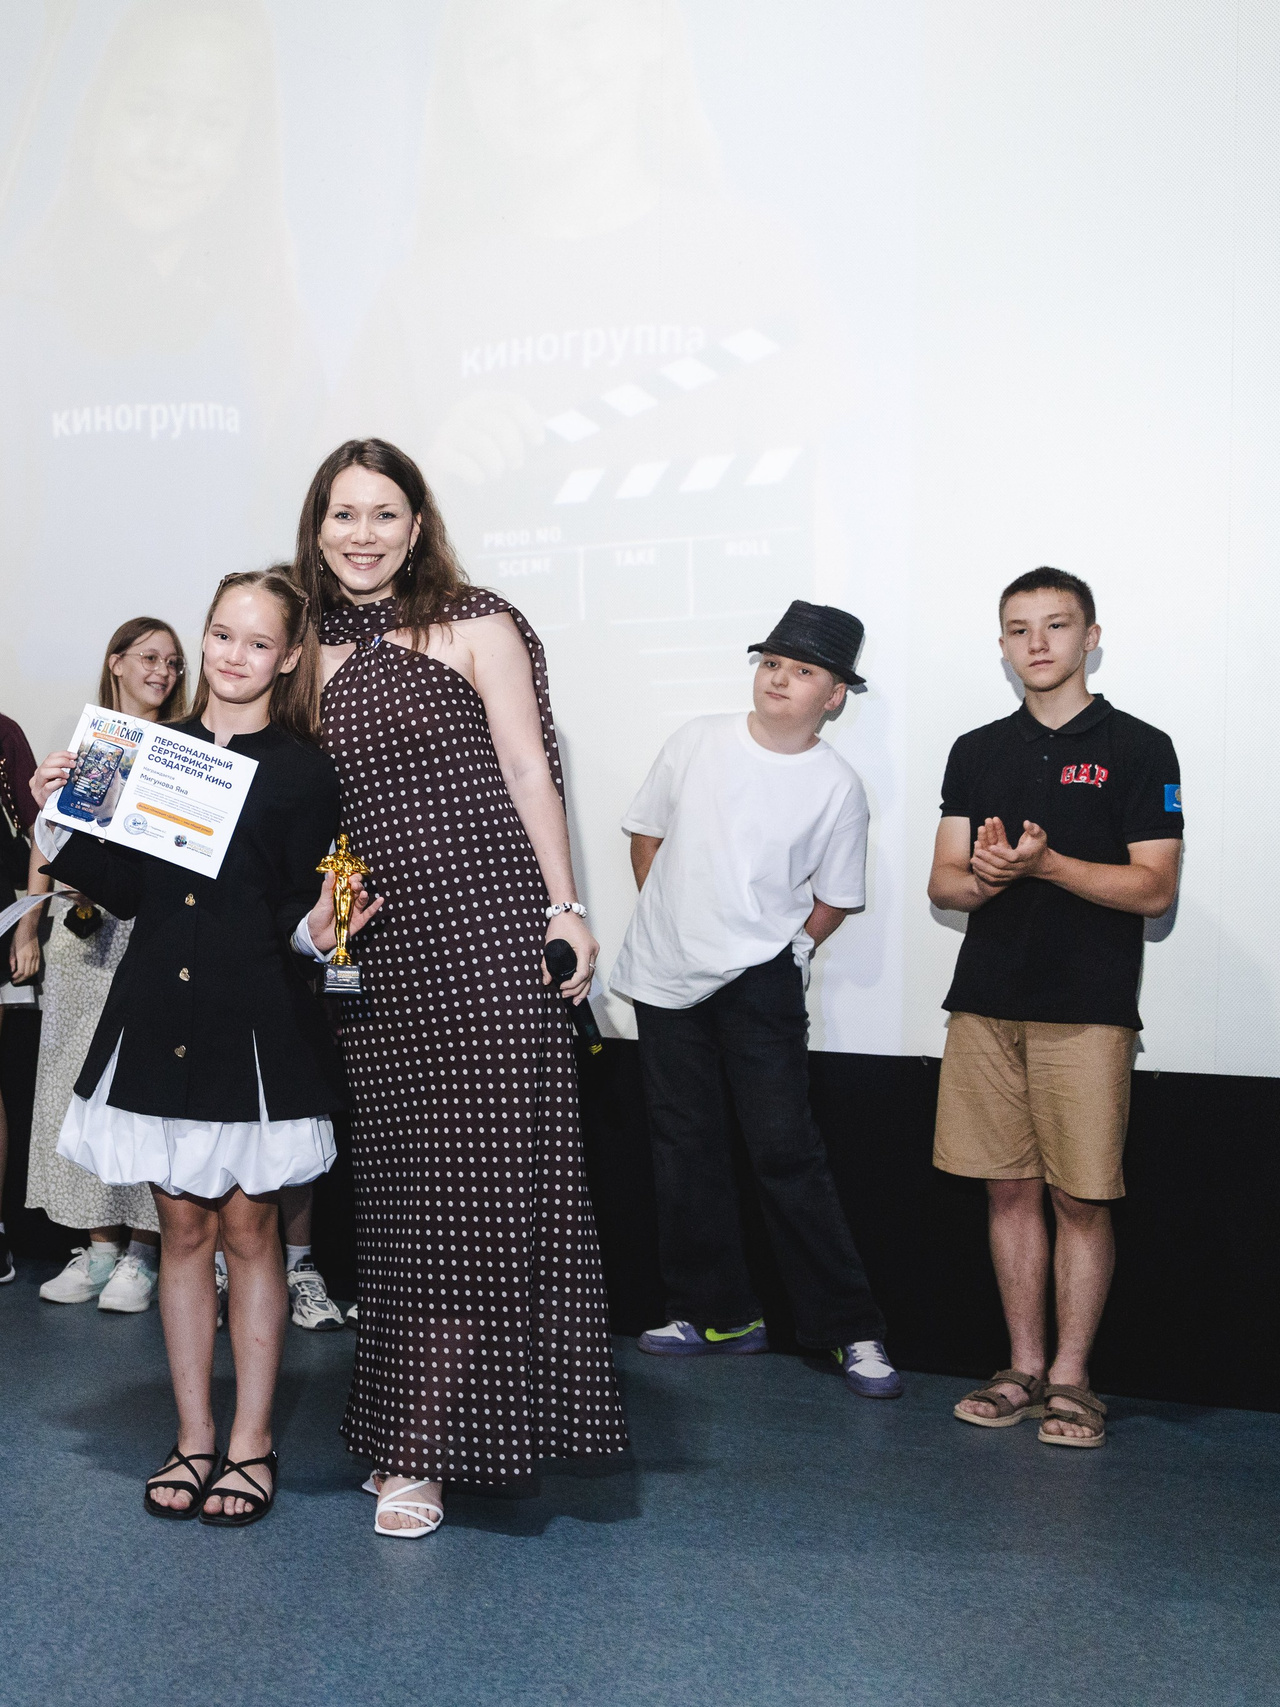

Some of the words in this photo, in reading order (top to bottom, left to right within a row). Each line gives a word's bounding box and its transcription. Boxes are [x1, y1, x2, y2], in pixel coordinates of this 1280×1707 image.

[459, 324, 708, 379] киногруппа
[51, 402, 241, 440] киногруппа
[90, 718, 144, 744] МЕДИАСКОП
[151, 745, 214, 773] СЕРТИФИКАТ
[154, 736, 233, 771] ПЕРСОНАЛЬНЫЙ
[147, 753, 204, 779] СОЗДАТЕЛЯ
[205, 774, 233, 790] КИНО
[1060, 763, 1109, 788] GAP
[175, 785, 188, 795] Яна
